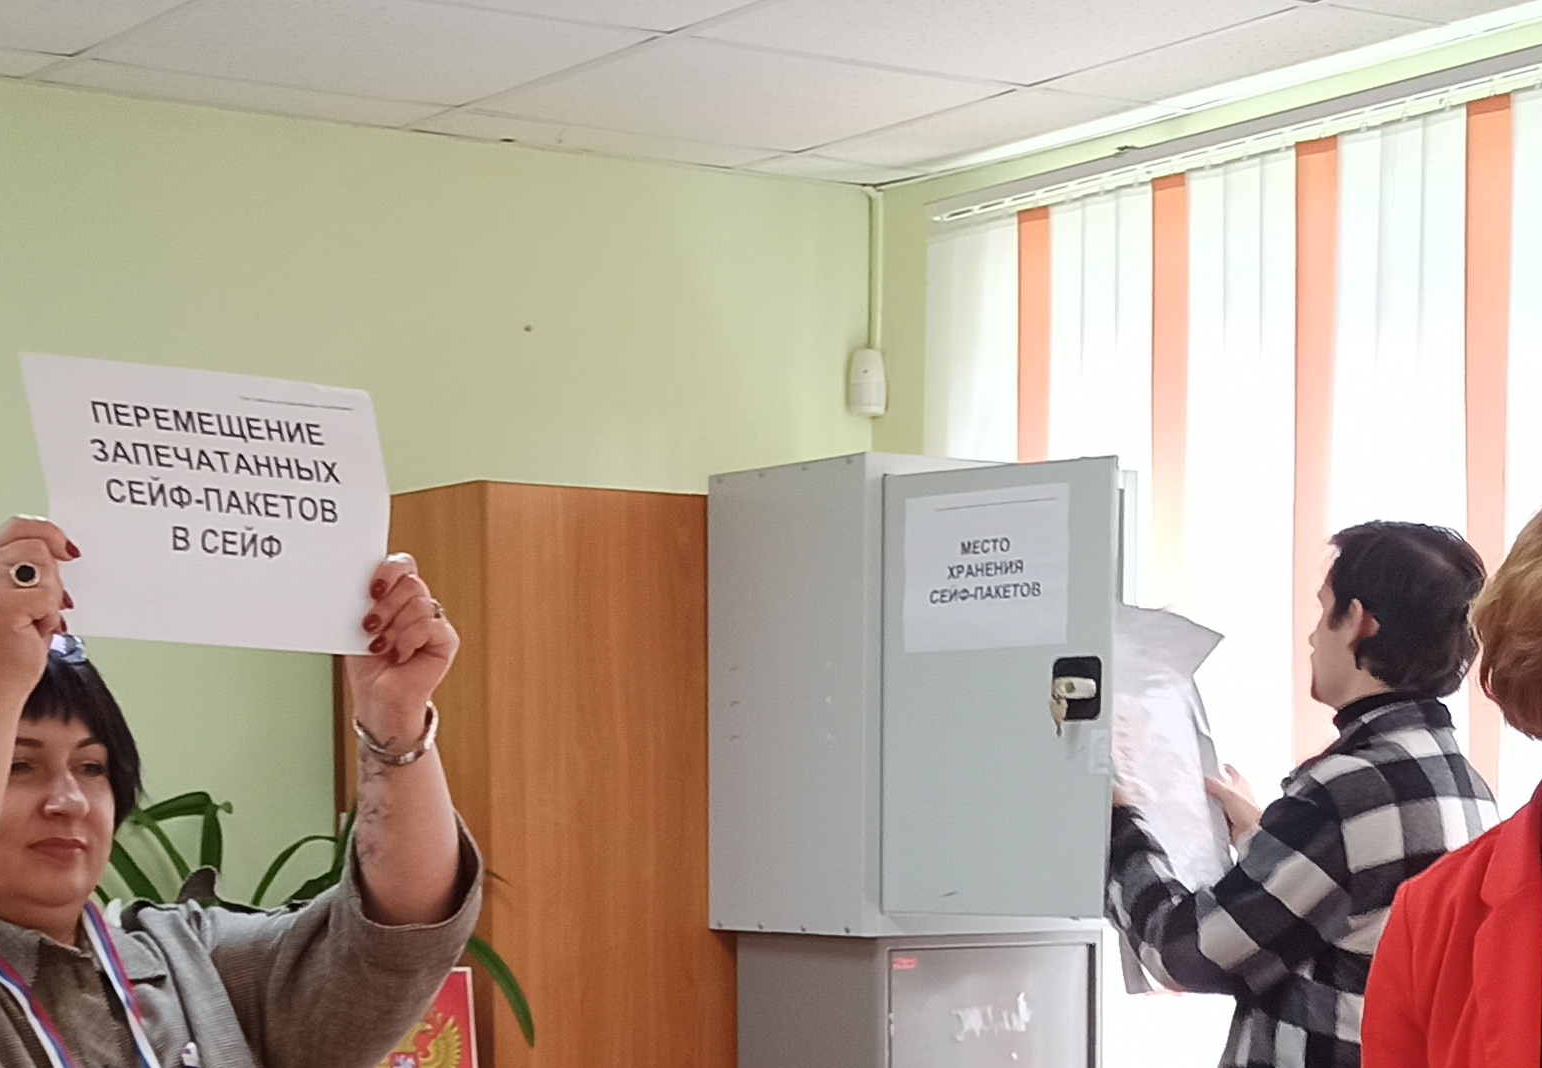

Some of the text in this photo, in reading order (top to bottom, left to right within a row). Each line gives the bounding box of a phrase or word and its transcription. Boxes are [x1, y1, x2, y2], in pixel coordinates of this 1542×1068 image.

[90, 400, 326, 447] ПЕРЕМЕЩЕНИЕ
[90, 438, 341, 485] ЗАПЕЧАТАННЫХ
[106, 476, 339, 524] СЕЙФ-ПАКЕТОВ
[172, 525, 283, 559] В СЕЙФ
[959, 536, 1011, 555] МЕСТО
[947, 559, 1024, 580] ХРАНЕНИЯ
[929, 582, 1042, 605] СЕЙФ-ПАКЕТОВ
